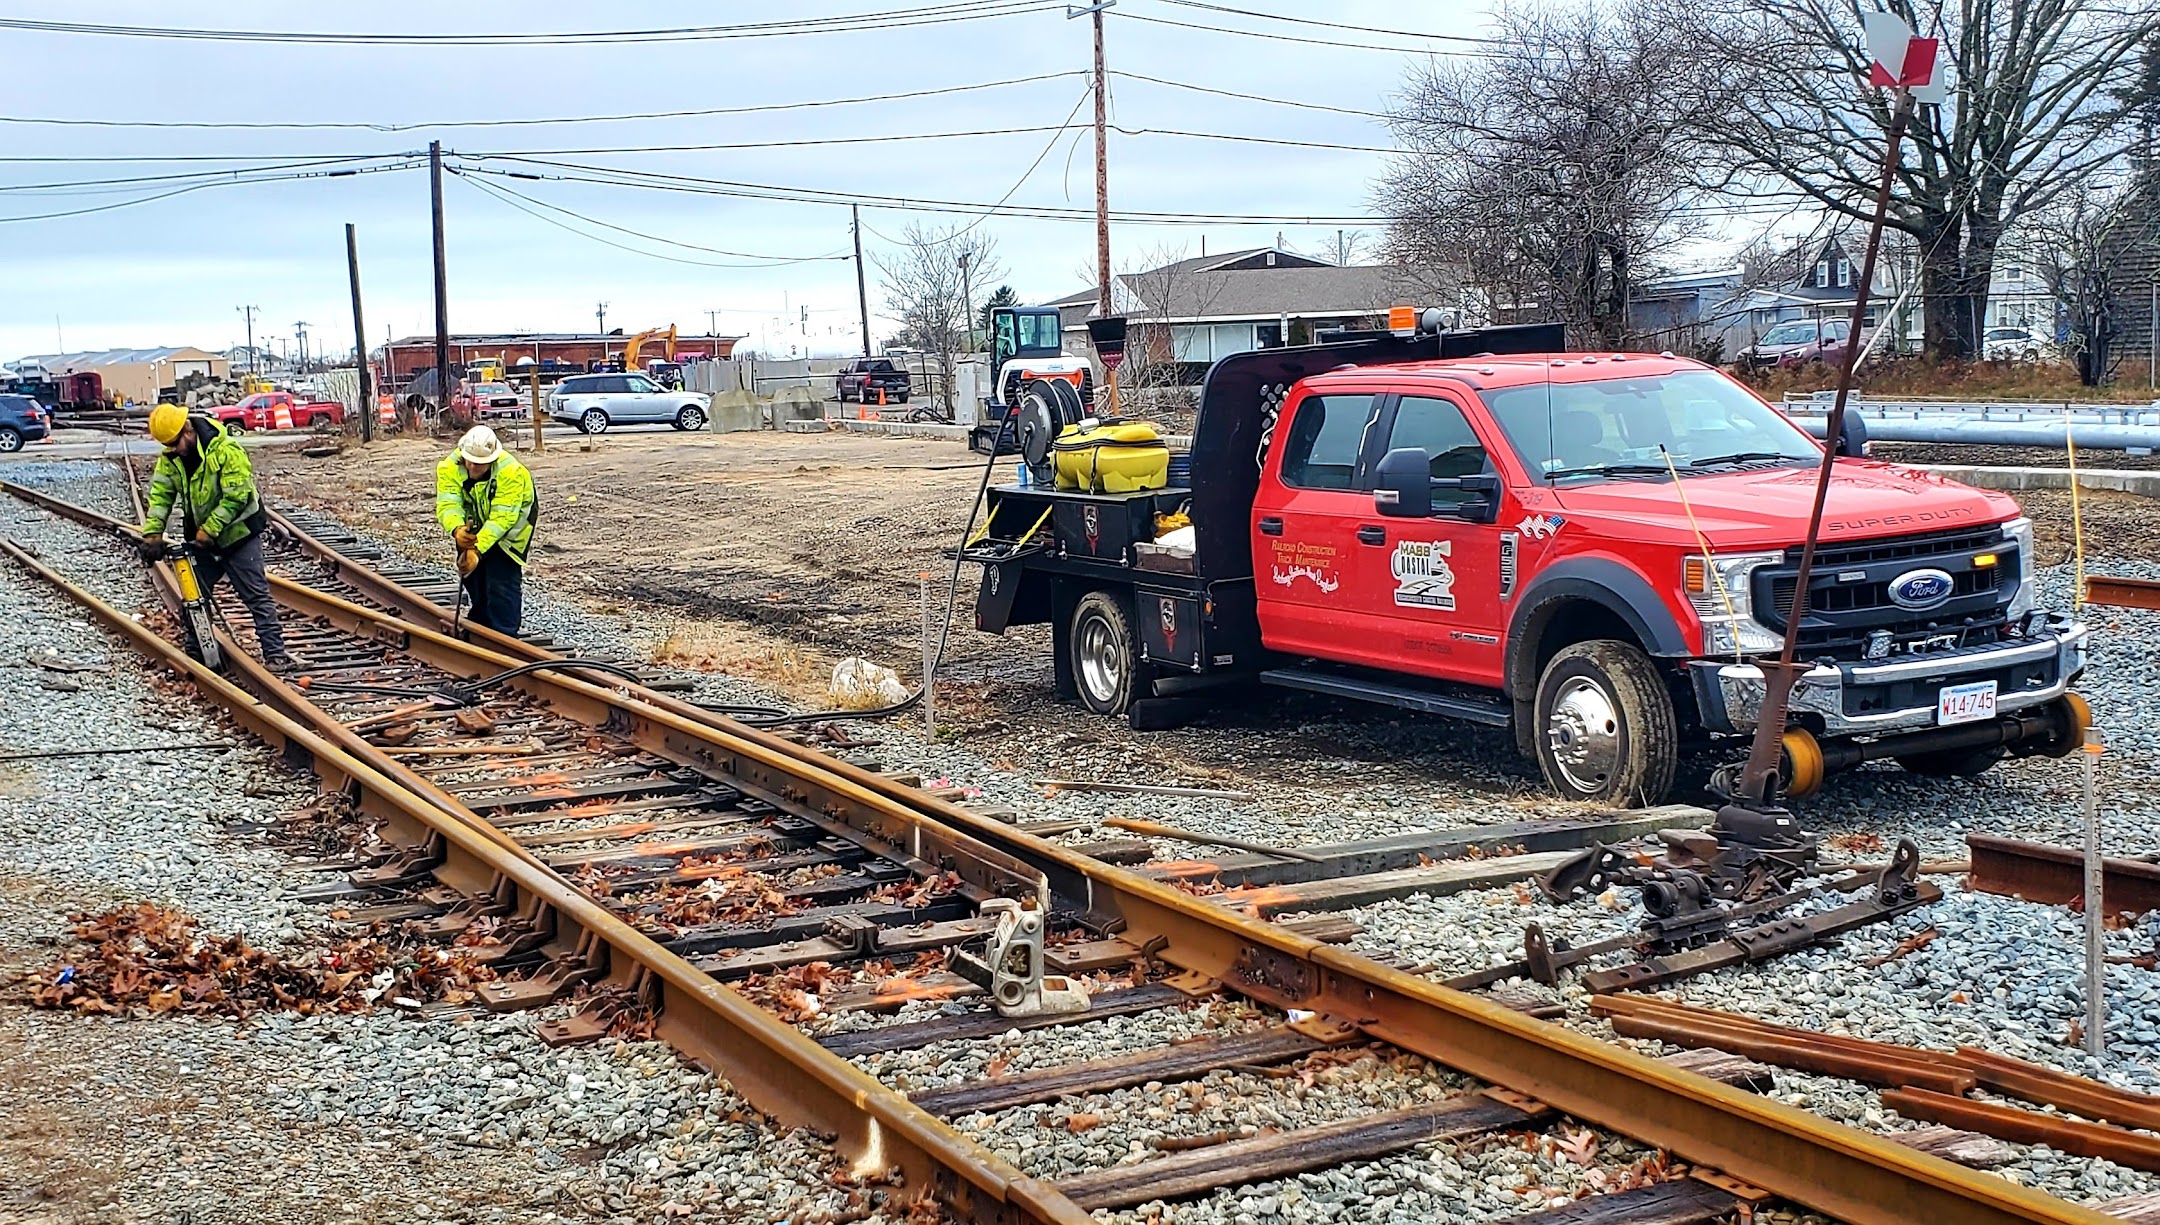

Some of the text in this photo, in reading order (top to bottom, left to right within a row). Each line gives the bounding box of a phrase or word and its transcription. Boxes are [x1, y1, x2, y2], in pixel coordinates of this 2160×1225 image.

[1828, 507, 1973, 531] SUPER DUTY
[1400, 543, 1430, 556] MABB
[1909, 579, 1939, 598] Ford
